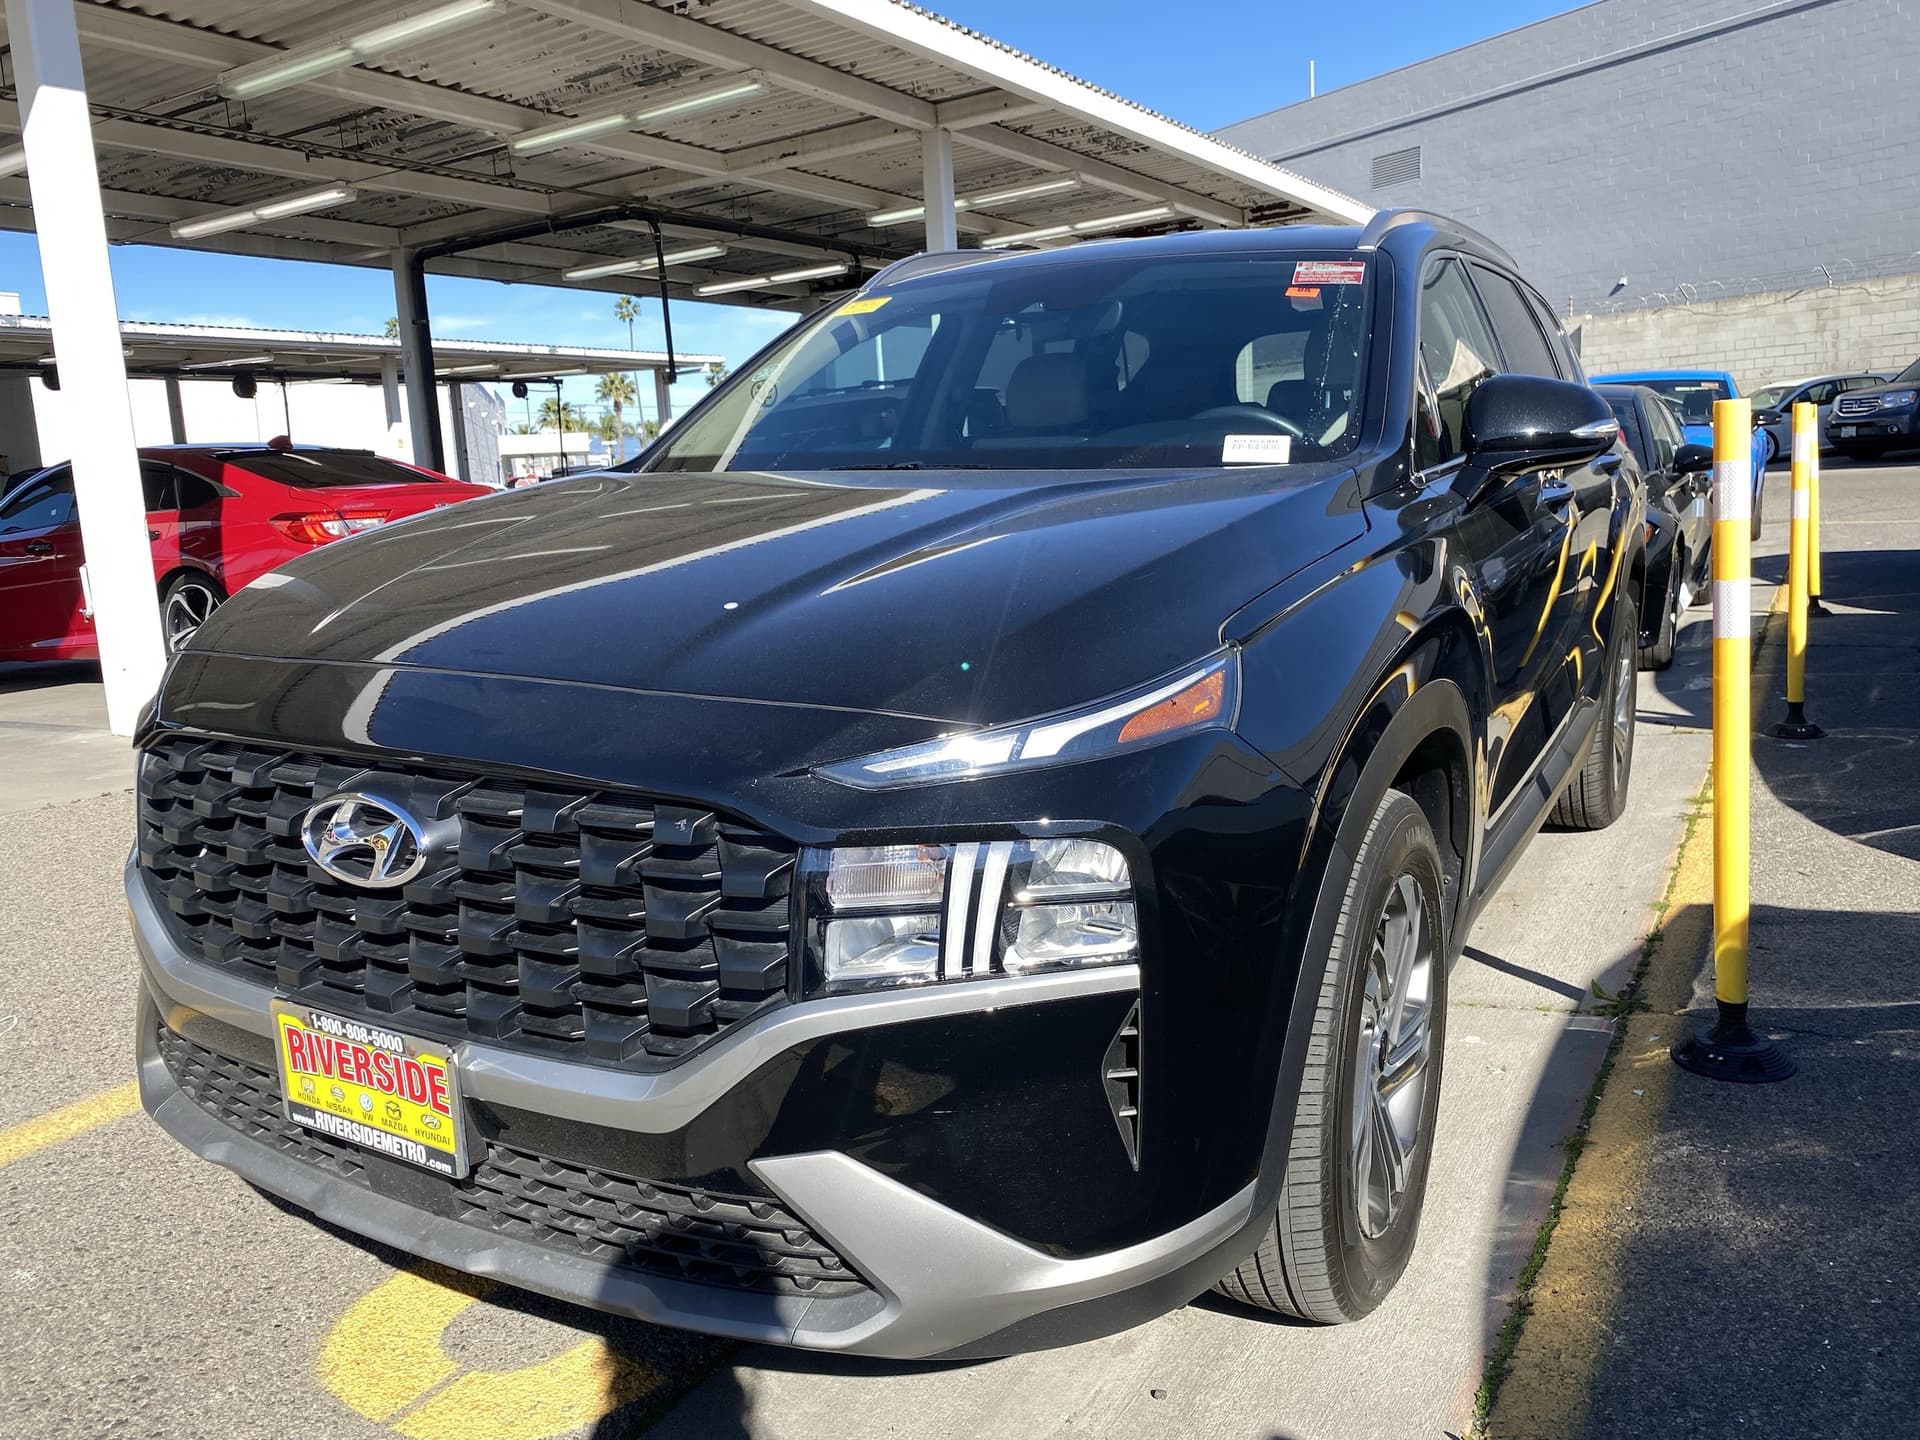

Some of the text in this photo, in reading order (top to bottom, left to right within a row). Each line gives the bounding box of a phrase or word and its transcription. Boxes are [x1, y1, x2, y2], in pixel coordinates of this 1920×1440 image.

[310, 1013, 404, 1053] 1-800-808-5000
[284, 1026, 452, 1117] RIVERSIDE
[292, 1110, 452, 1174] www.RIVERSIDEMETRO.com
[297, 1090, 450, 1145] HONDA NISSAN VW MAZDA HYUNDAI
